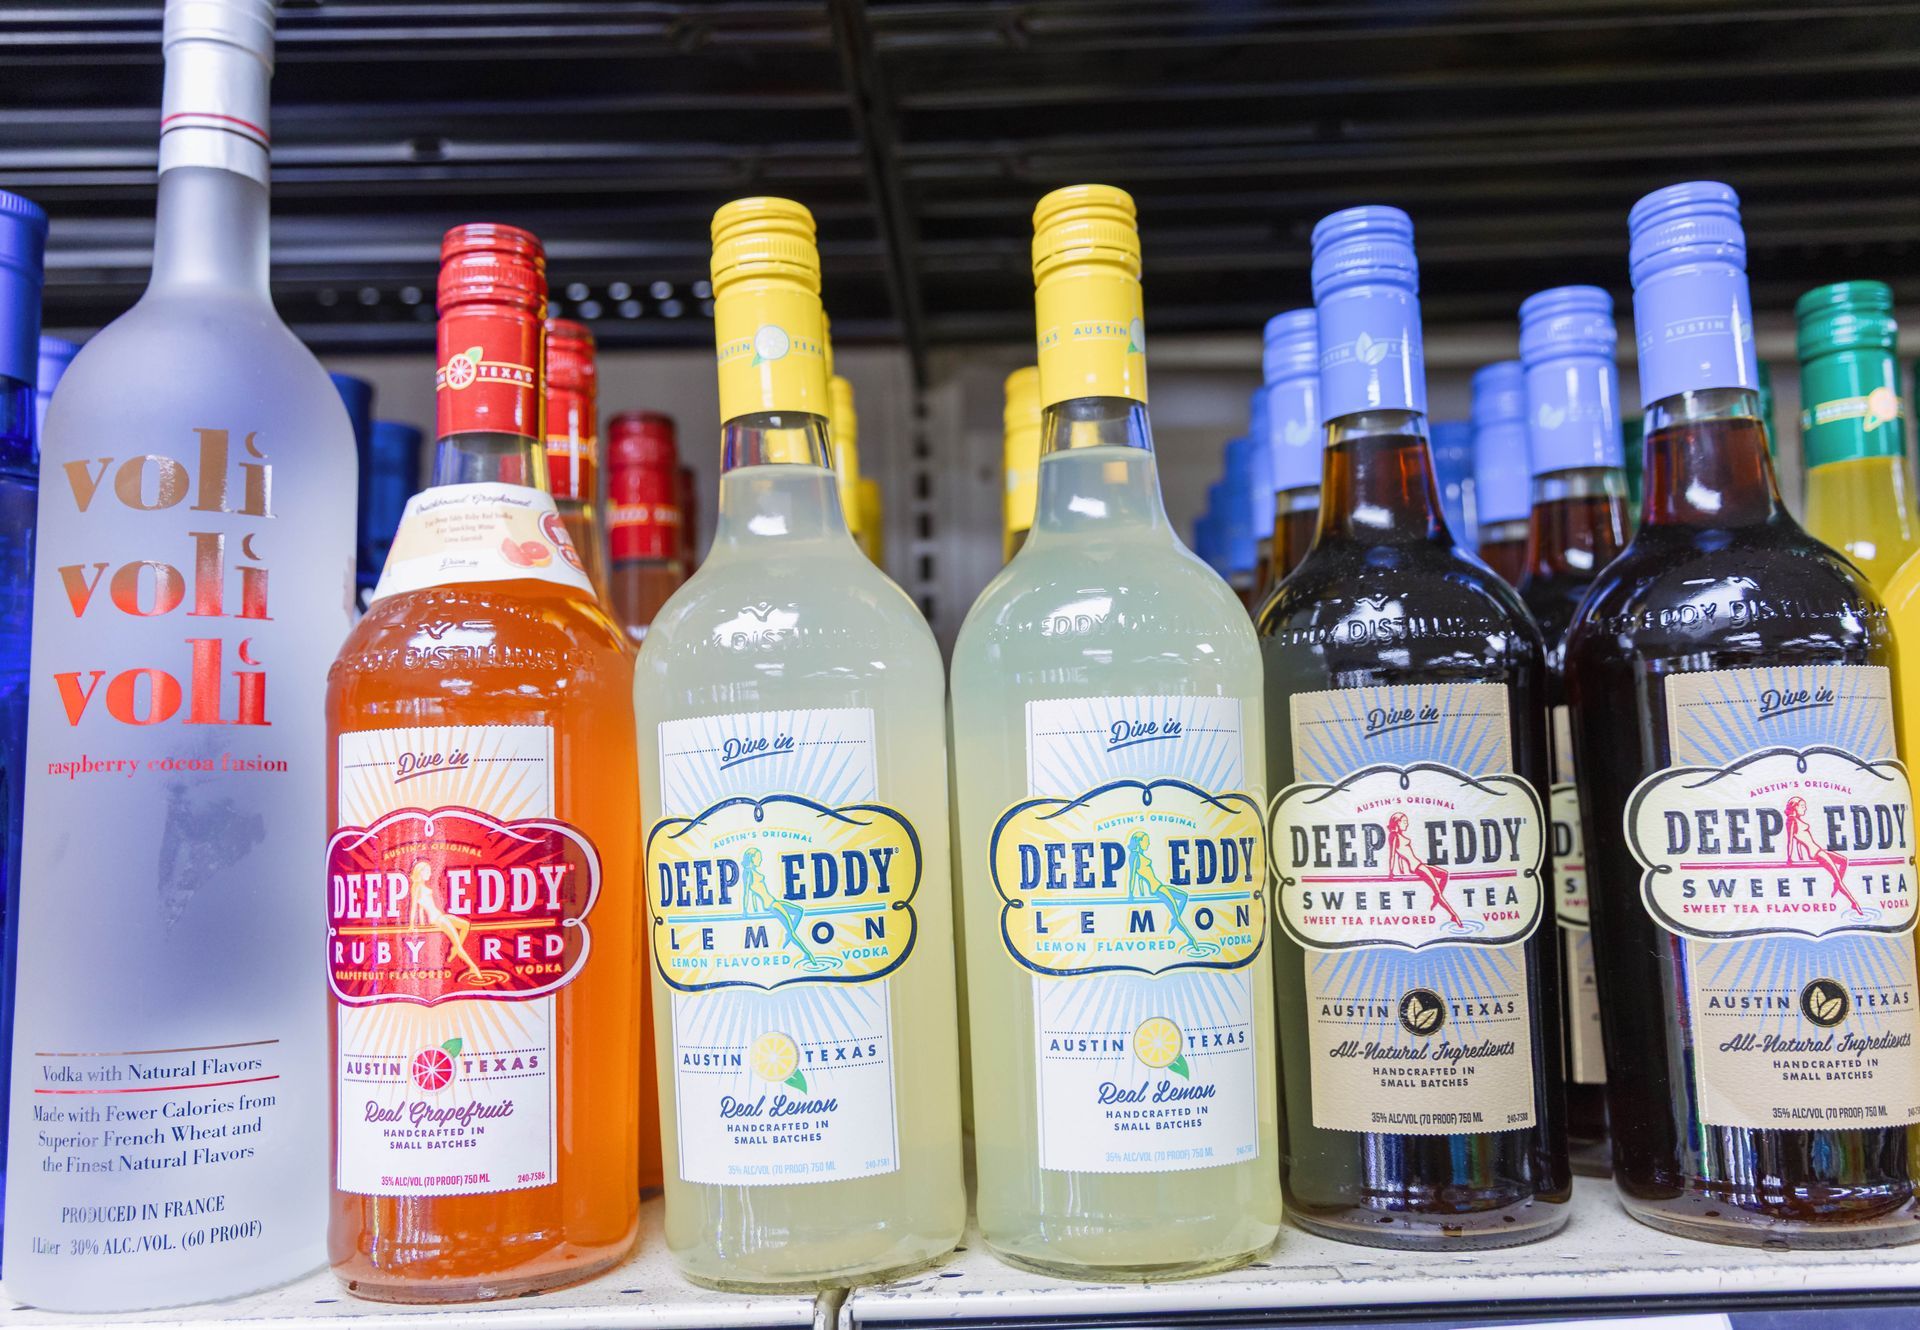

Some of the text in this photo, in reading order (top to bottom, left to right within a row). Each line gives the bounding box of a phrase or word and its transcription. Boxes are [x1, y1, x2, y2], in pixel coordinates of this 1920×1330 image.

[1074, 326, 1126, 336] AUSTIN
[480, 366, 532, 382] TEXAS
[62, 428, 278, 518] voli
[58, 532, 274, 621] voli
[54, 638, 272, 726] voli
[1760, 686, 1834, 712] Dive in
[1366, 704, 1439, 731] Dive in
[1109, 718, 1182, 743] Dive in
[722, 733, 794, 761] Dive in
[48, 752, 287, 780] raspberry cocoa fusion
[396, 749, 469, 775] Dive in
[1750, 780, 1852, 798] AUSTIN'S ORIGINAL
[1357, 797, 1455, 813] AUSTIN'S ORIGINAL
[1097, 815, 1197, 832] AUSTIN'S ORIGINAL
[1664, 803, 1905, 855] DEEP EDDY
[714, 831, 812, 849] AUSTIN'S ORIGINAL
[1290, 823, 1386, 868] DEEP
[1425, 817, 1521, 865] EDDY
[383, 843, 482, 860] AUSTIN'S ORIGINAL
[1018, 838, 1254, 890] DEEP EDDY
[658, 847, 893, 907] DEEP EDDY
[1683, 873, 1907, 898] SWEET TEA
[334, 864, 566, 919] DEEP EDDY
[1303, 886, 1518, 910] SWEET TEA
[1683, 899, 1909, 913] SWEET TEA FLAVORED VODKA
[1304, 910, 1520, 925] SWEET TEA FLAVORED VODKA
[336, 935, 564, 964] RUBY RED
[1037, 934, 1251, 951] LEMON FLAVORED VODKA
[672, 946, 888, 967] LEMON FLAVORED VODKA
[336, 963, 562, 981] GRAPEFRUIT FLAVORED VODKA
[1322, 1001, 1515, 1019] AUSTIN TEXAS
[1709, 992, 1909, 1009] AUSTIN TEXAS
[1050, 1031, 1245, 1052] AUSTIN TEXAS
[1329, 1039, 1515, 1065] All-Natural Ingredients
[1720, 1030, 1911, 1057] All-Natural Ingredients
[347, 1056, 539, 1076] AUSTIN TEXAS
[683, 1044, 877, 1067] AUSTIN TEXAS
[1773, 1059, 1879, 1069] HANDCRAFTED IN
[43, 1058, 262, 1082] Vodka with Natural Flavors
[1373, 1066, 1475, 1076] HANDCRAFTED IN
[1783, 1070, 1873, 1080] SMALL BATCHES
[1098, 1081, 1216, 1105] Real Lemon
[1381, 1078, 1469, 1088] SMALL BATCHES
[33, 1094, 276, 1122] Made with Fewer Calories from
[365, 1100, 513, 1127] Real Grapefruit
[720, 1095, 838, 1118] Real Lemon
[1106, 1106, 1208, 1119] HANDCRAFTED IN
[1772, 1105, 1887, 1120] 35% ALC/VOL (70 PROOF) 750 ML
[727, 1120, 829, 1133] HANDCRAFTED IN
[1114, 1119, 1202, 1131] SMALL BATCHES
[1372, 1111, 1483, 1125] 35% ALC/VOL (70 PROOF) 750 ML
[38, 1117, 262, 1152] Superior French Wheat and
[384, 1126, 484, 1138] HANDCRAFTED IN
[734, 1133, 822, 1145] SMALL BATCHES
[390, 1139, 477, 1150] SMALL BATCHES
[43, 1146, 254, 1172] the Finest Natural Flavors
[381, 1171, 545, 1187] 35% ALC/VOL (70 PROOF) 750 ML 240-7586
[62, 1195, 225, 1223] PRODUCED IN FRANCE
[70, 1220, 262, 1256] 30% ALC./VOL. (60 PROOF)
